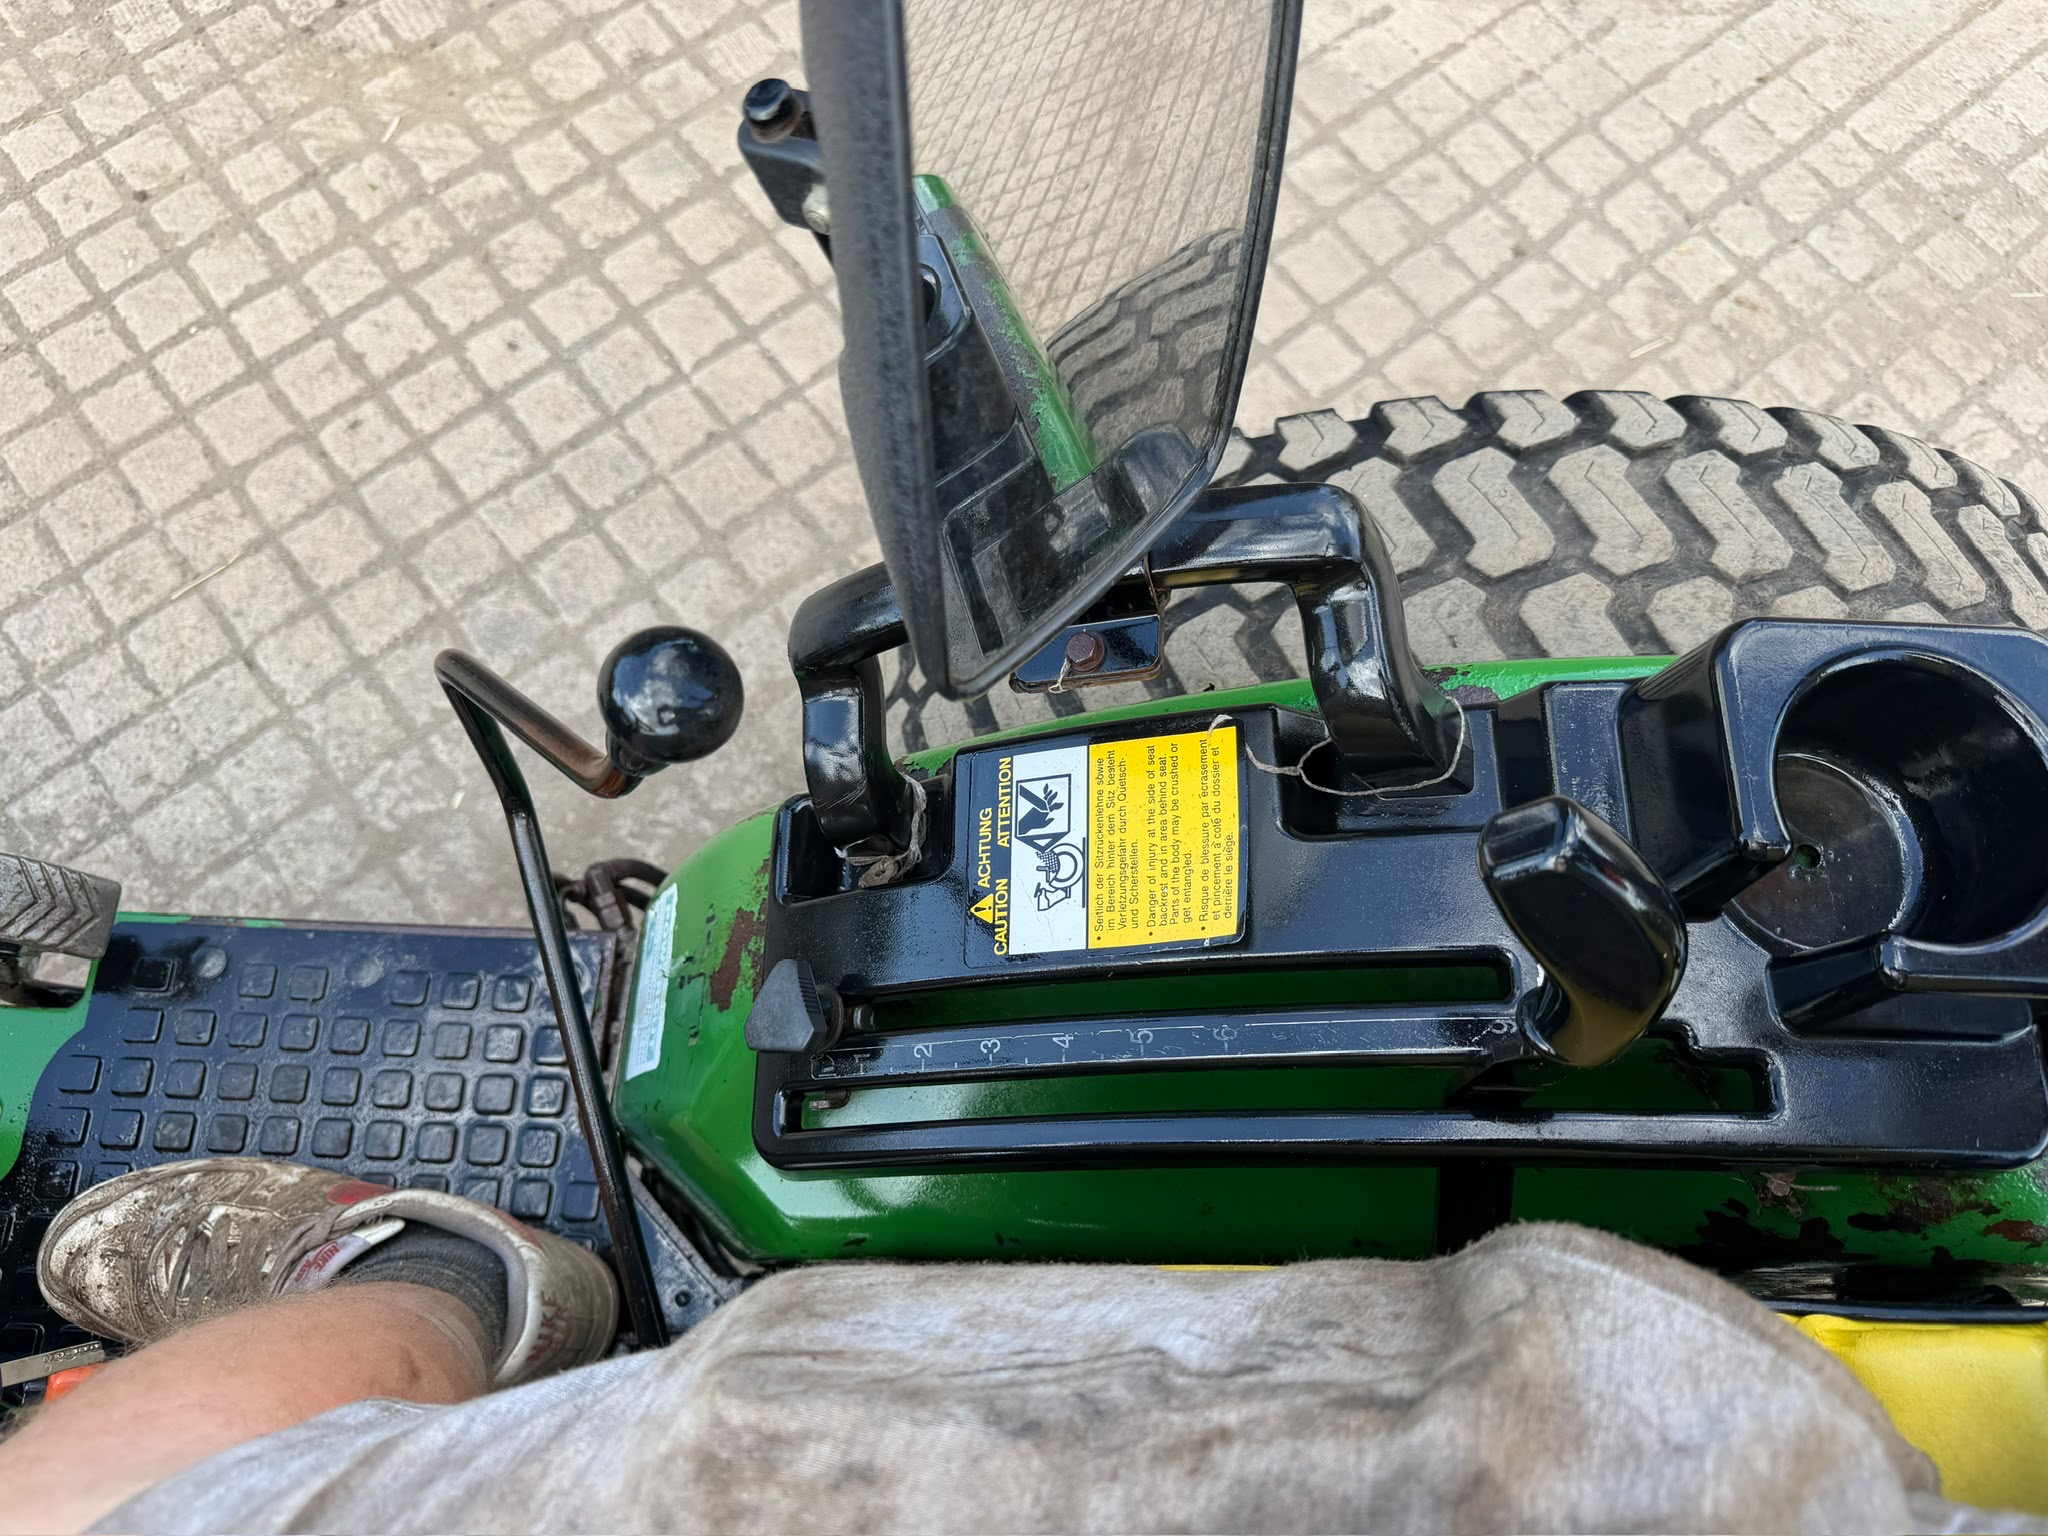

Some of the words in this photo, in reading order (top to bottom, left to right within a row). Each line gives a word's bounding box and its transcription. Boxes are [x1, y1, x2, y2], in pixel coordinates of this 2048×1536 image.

[1147, 745, 1155, 766] seat
[1171, 743, 1178, 752] or
[1211, 746, 1220, 756] et
[1096, 758, 1104, 786] sowie
[1107, 750, 1115, 786] besteht
[1117, 757, 1126, 802] Quetsch-
[1146, 770, 1155, 779] of
[1170, 755, 1179, 796] crushed
[1198, 739, 1209, 798] écrasement
[1211, 760, 1220, 796] dossier
[997, 757, 1012, 848] ATTENTION
[1106, 790, 1115, 808] Sitz
[1147, 784, 1155, 804] side
[1159, 781, 1167, 816] behind
[1170, 798, 1179, 812] be
[1118, 805, 1126, 834] durch
[1147, 808, 1156, 824] the
[1201, 802, 1211, 818] par
[1212, 801, 1221, 814] du
[1094, 789, 1104, 869] Sitzrückenlehne
[1107, 814, 1115, 835] dem
[1148, 829, 1156, 838] at
[1160, 819, 1168, 841] area
[1172, 815, 1181, 836] may
[978, 807, 992, 888] ACHTUNG
[1107, 840, 1116, 869] hinter
[1159, 846, 1168, 854] in
[1170, 839, 1182, 864] body
[1200, 822, 1210, 864] blessure
[1211, 841, 1221, 849] à
[1223, 832, 1236, 861] siège.
[1147, 843, 1158, 871] injury
[1159, 859, 1168, 878] and
[1096, 873, 1104, 890] der
[1129, 839, 1139, 904] Scherstellen.
[1147, 876, 1156, 885] of
[1171, 867, 1180, 883] the
[1183, 850, 1194, 903] entangled.
[1200, 869, 1209, 882] de
[1213, 852, 1222, 906] pincement
[1224, 865, 1233, 875] le
[1106, 874, 1116, 912] Bereich
[1118, 838, 1129, 930] Verletzungsgefahr
[1171, 887, 1180, 896] of
[1147, 889, 1158, 928] Danger
[1159, 884, 1168, 926] backrest
[1170, 899, 1180, 924] Parts
[1199, 886, 1211, 921] Risque
[1223, 880, 1232, 919] derrière
[994, 878, 1008, 956] CAUTION
[1094, 894, 1104, 932] Seitlich
[1107, 919, 1115, 931] im
[1129, 909, 1139, 929] und
[1183, 907, 1193, 924] get
[1212, 910, 1220, 920] et
[914, 1044, 932, 1058] 2
[980, 1039, 1000, 1054] 3
[1052, 1033, 1074, 1048] 4
[1125, 1028, 1154, 1044] 5
